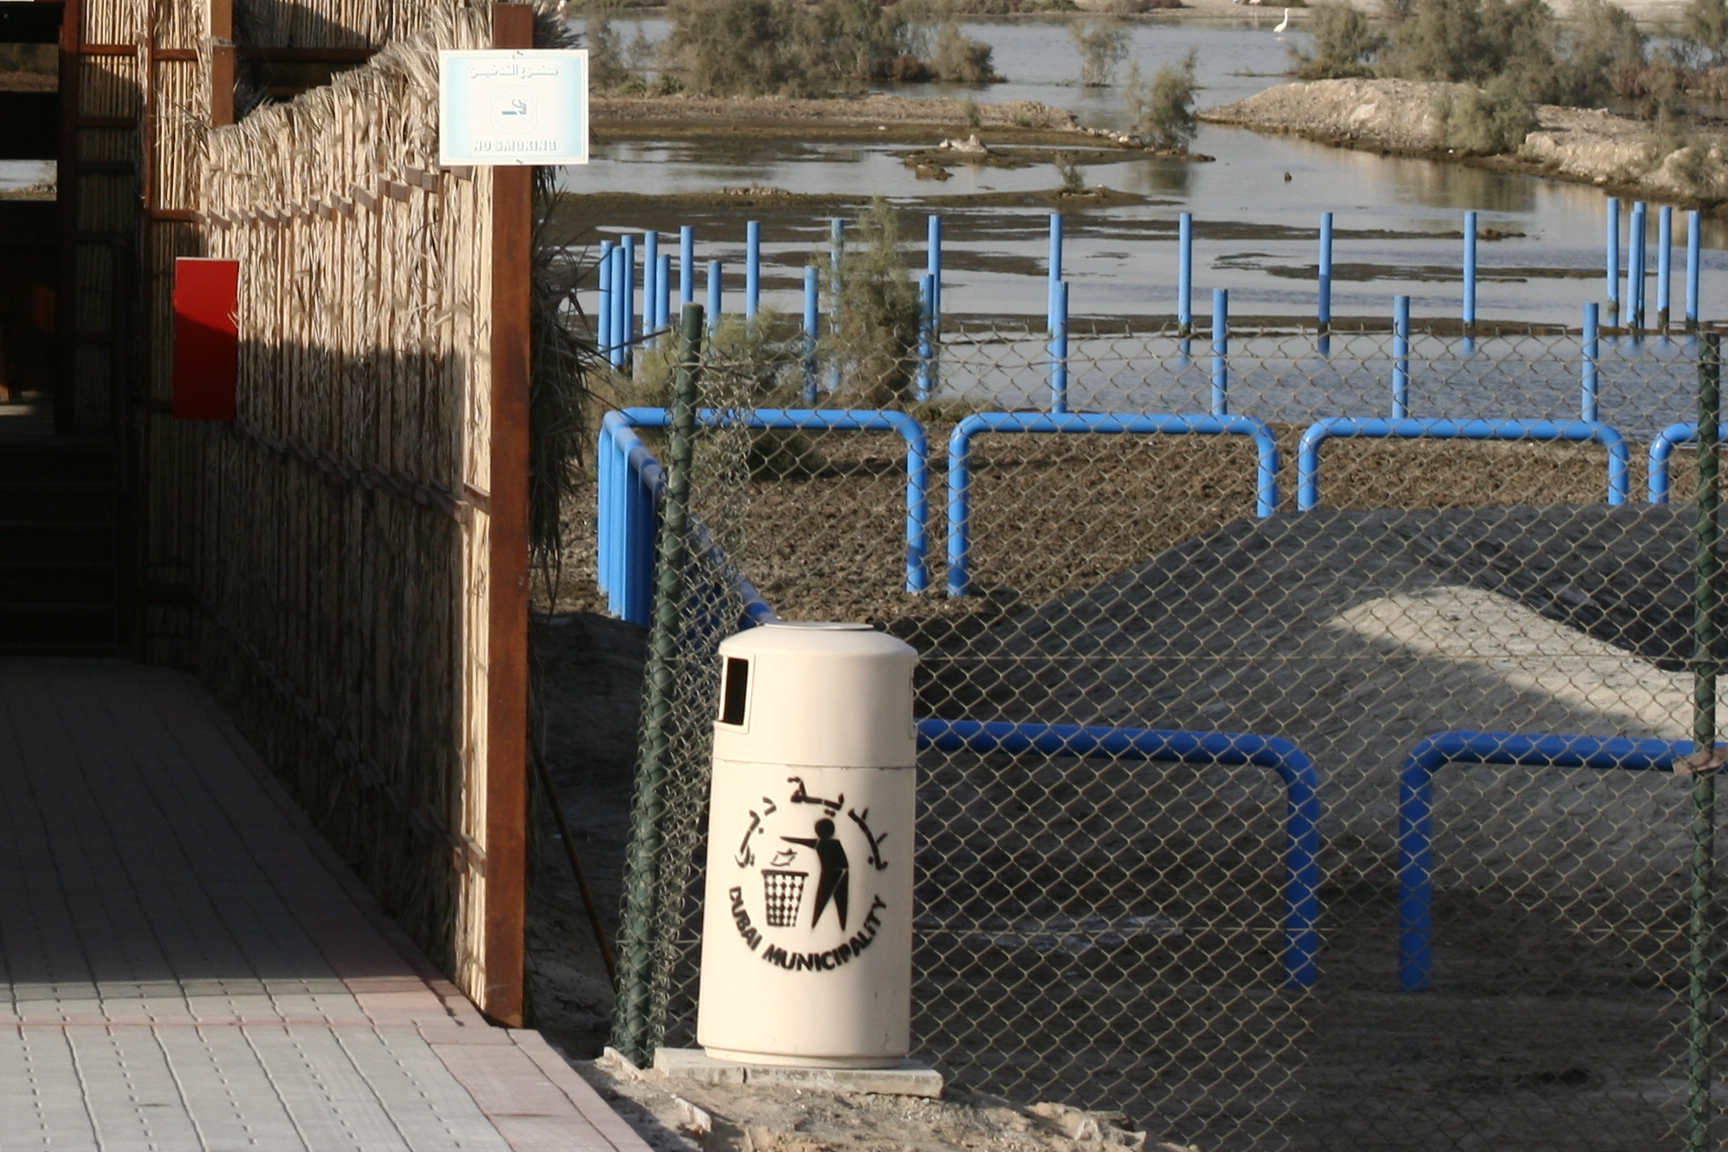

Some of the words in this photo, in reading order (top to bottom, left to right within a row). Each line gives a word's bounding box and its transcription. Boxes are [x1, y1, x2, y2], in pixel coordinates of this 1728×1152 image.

[473, 140, 492, 151] NO
[495, 140, 557, 151] SMOKING
[728, 885, 763, 951] DUBAI
[762, 894, 887, 972] MUNICIPALITY
